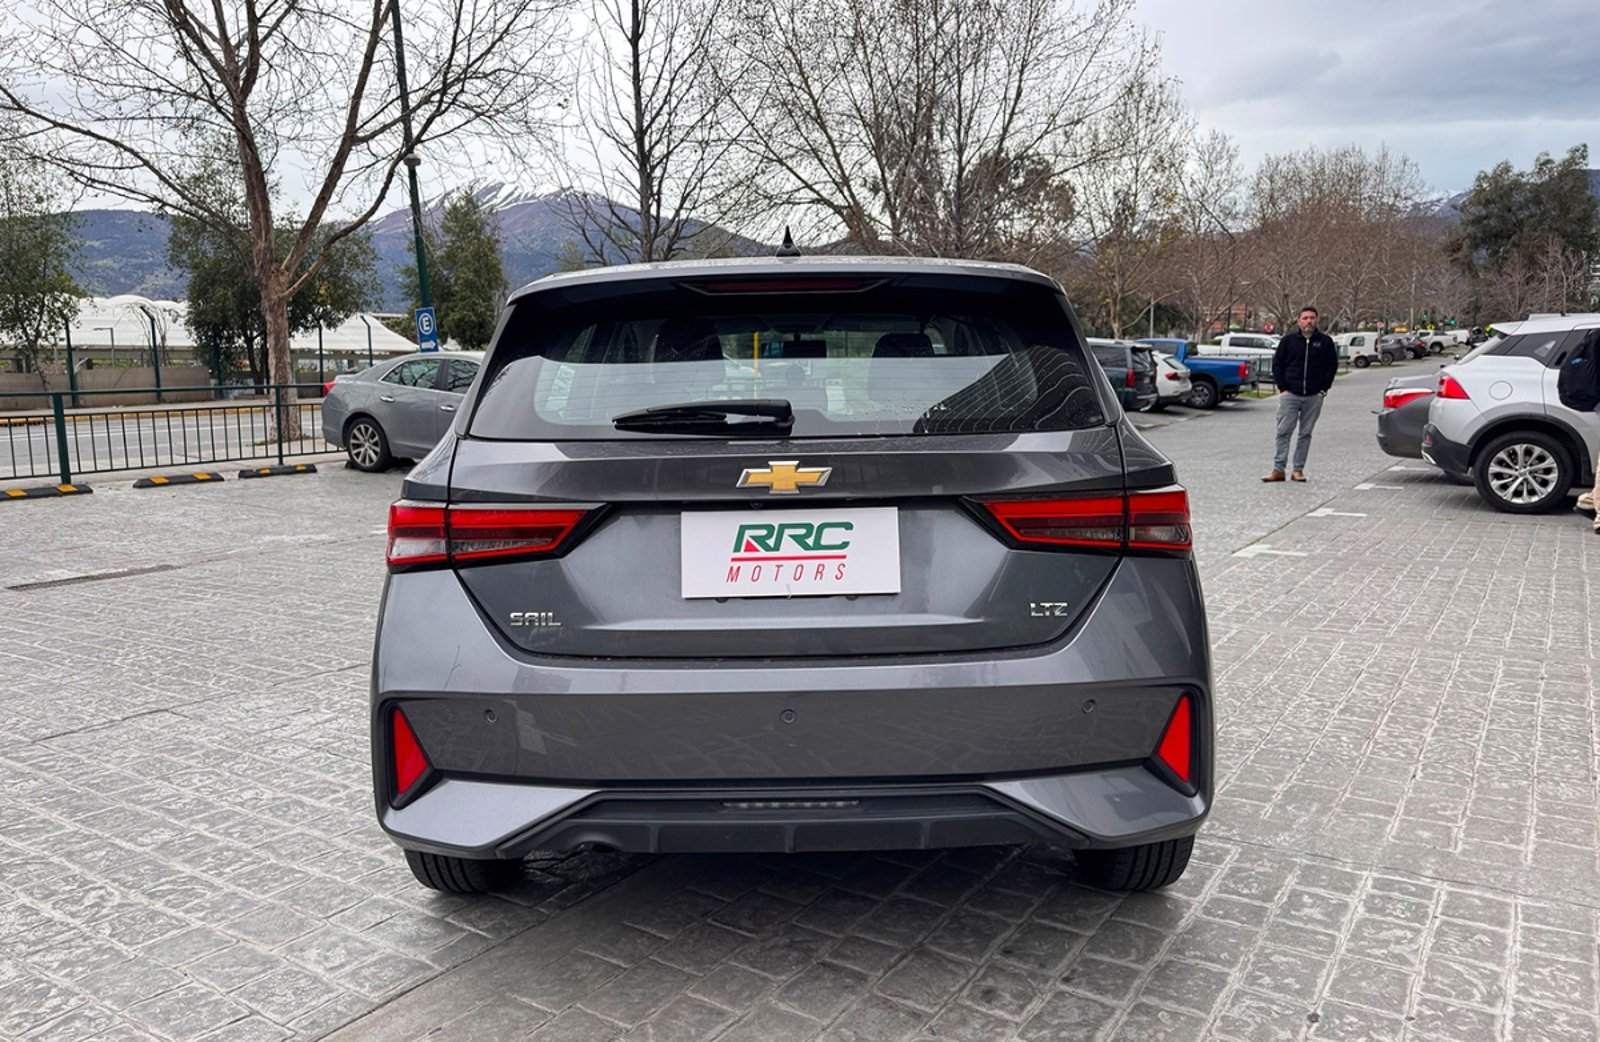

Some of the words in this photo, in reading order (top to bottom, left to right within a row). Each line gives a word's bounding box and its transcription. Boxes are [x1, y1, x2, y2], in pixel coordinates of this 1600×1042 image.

[422, 316, 430, 331] E
[733, 522, 854, 553] RRC
[726, 563, 846, 583] MOTORS
[1030, 602, 1068, 617] LTZ
[510, 612, 562, 626] SAIL
